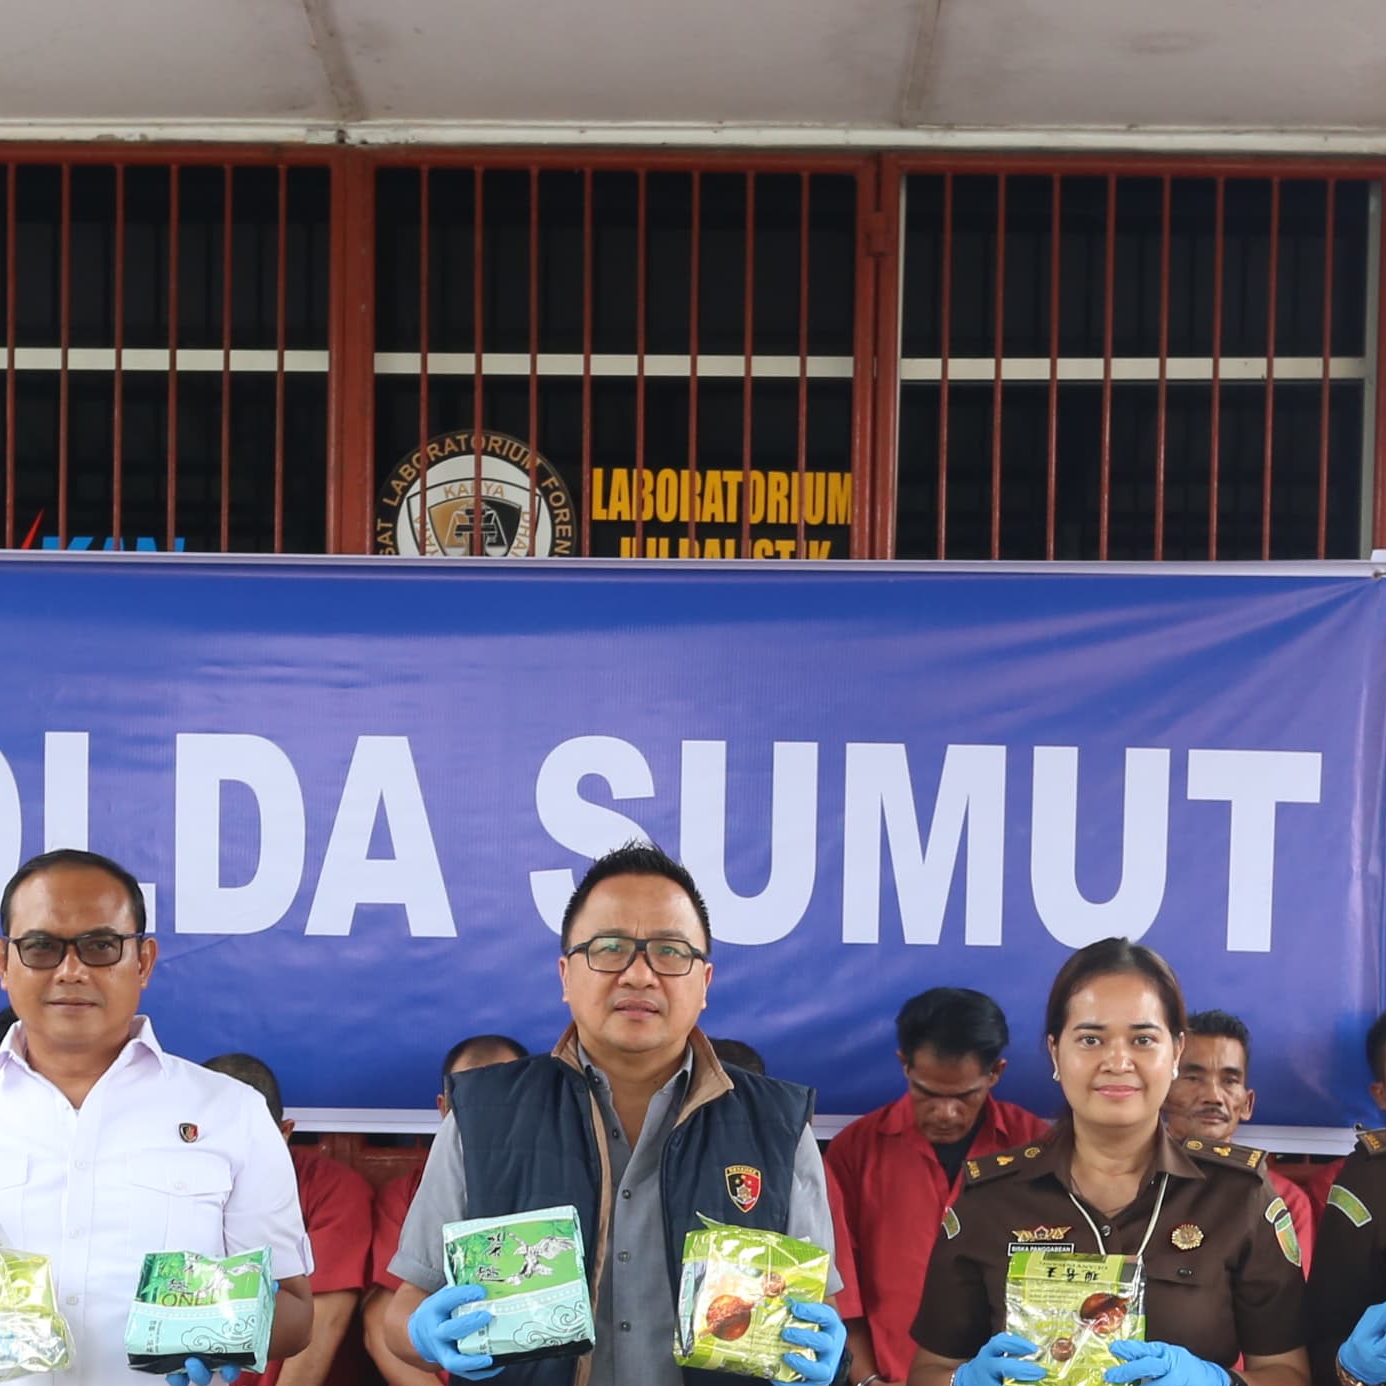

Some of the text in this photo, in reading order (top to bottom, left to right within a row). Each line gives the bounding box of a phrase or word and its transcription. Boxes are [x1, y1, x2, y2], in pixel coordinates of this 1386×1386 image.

[443, 481, 506, 498] KAYA
[540, 476, 573, 556] FOREN
[591, 467, 852, 525] LABORATORIUM
[529, 735, 1322, 953] SUMUT
